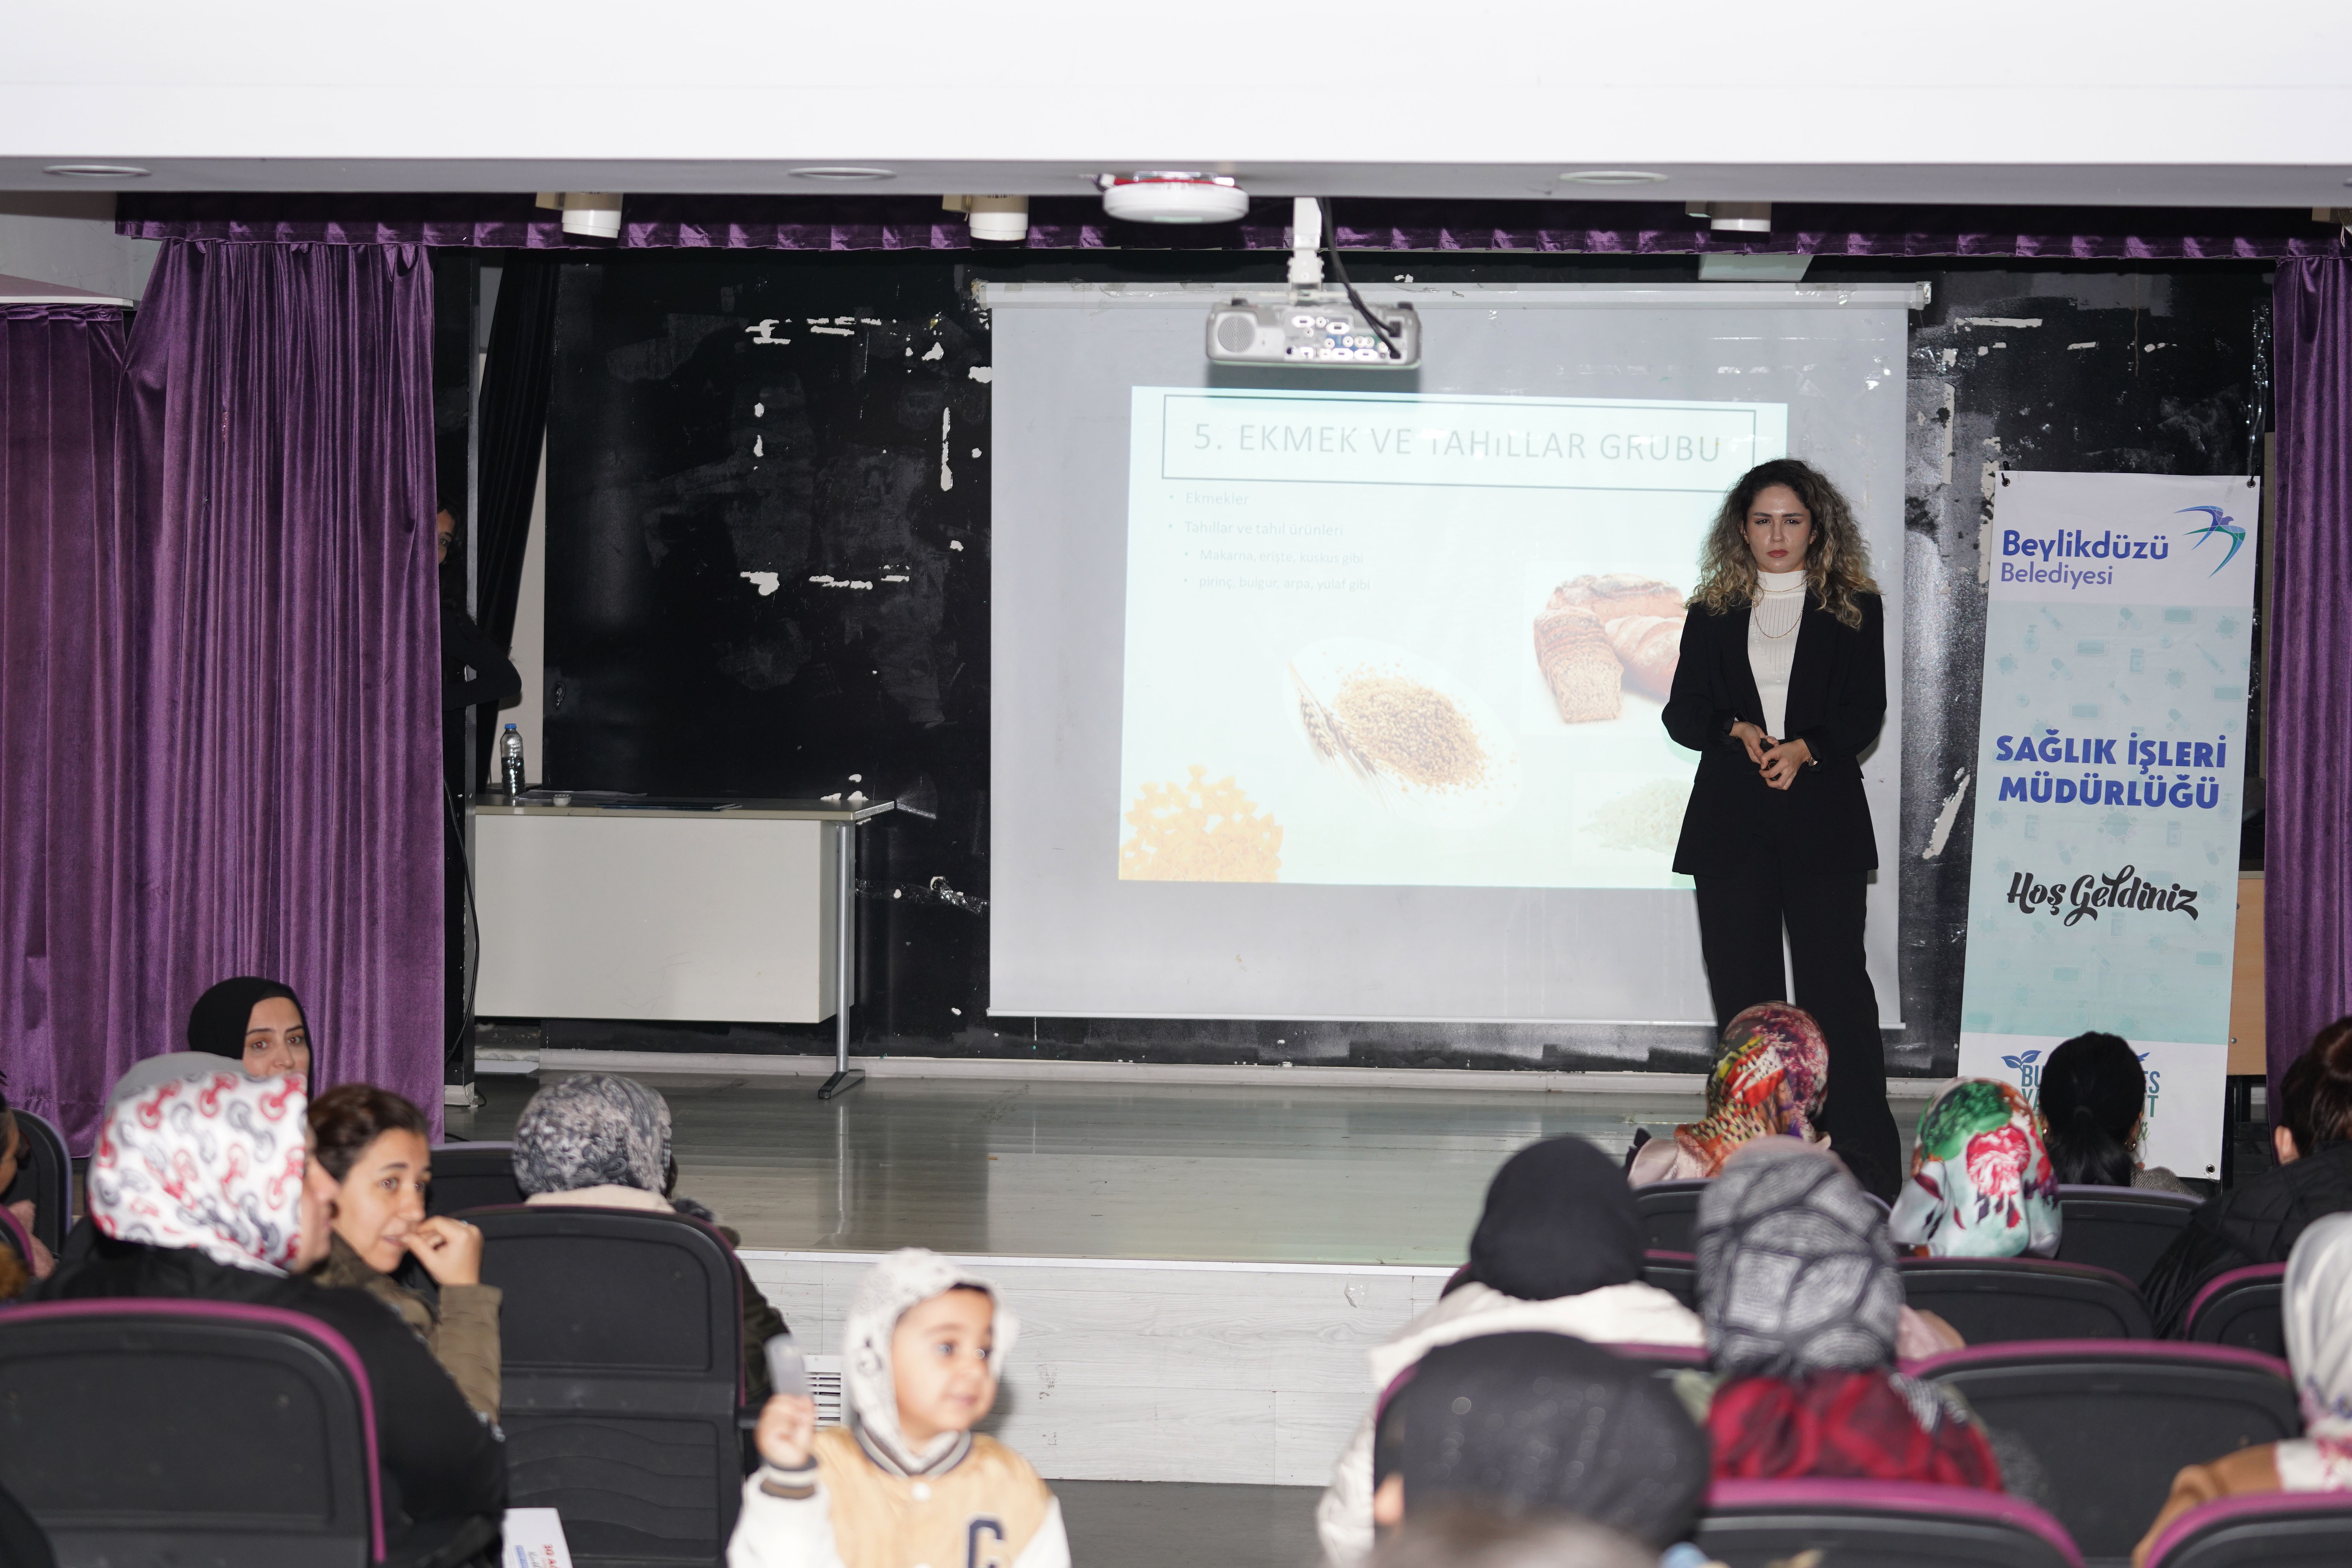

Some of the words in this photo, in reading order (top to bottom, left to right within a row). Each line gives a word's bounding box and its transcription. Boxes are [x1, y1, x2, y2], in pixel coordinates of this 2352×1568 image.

[1194, 423, 1222, 450] 5.
[1240, 424, 1357, 452] EKMEK
[1371, 428, 1411, 454] VE
[1600, 434, 1719, 462] GRUBU
[1186, 491, 1249, 505] Ekmekler
[1184, 521, 1233, 533] Tahıllar
[1237, 525, 1253, 534] ve
[1256, 522, 1285, 534] tahıl
[1289, 523, 1344, 536] ürünleri
[1199, 549, 1256, 563] Makarna,
[1260, 551, 1296, 564] erişte,
[1300, 551, 1340, 563] kuskus
[1342, 552, 1364, 566] gibi
[2002, 529, 2169, 561] Beylikdüzü
[1199, 576, 1236, 589] pirinç,
[1239, 576, 1280, 590] bulgur,
[1283, 580, 1313, 591] arpa,
[1316, 577, 1347, 591] yulaf
[1349, 579, 1370, 592] gibi
[2001, 561, 2113, 590] Belediyesi
[1996, 729, 2117, 764] SAĞLIK
[2128, 732, 2226, 775] İŞLERİ
[1999, 771, 2219, 809] MÜDÜRLÜĞÜ
[2007, 872, 2066, 915] Hoş
[2064, 864, 2199, 926] Geldiniz
